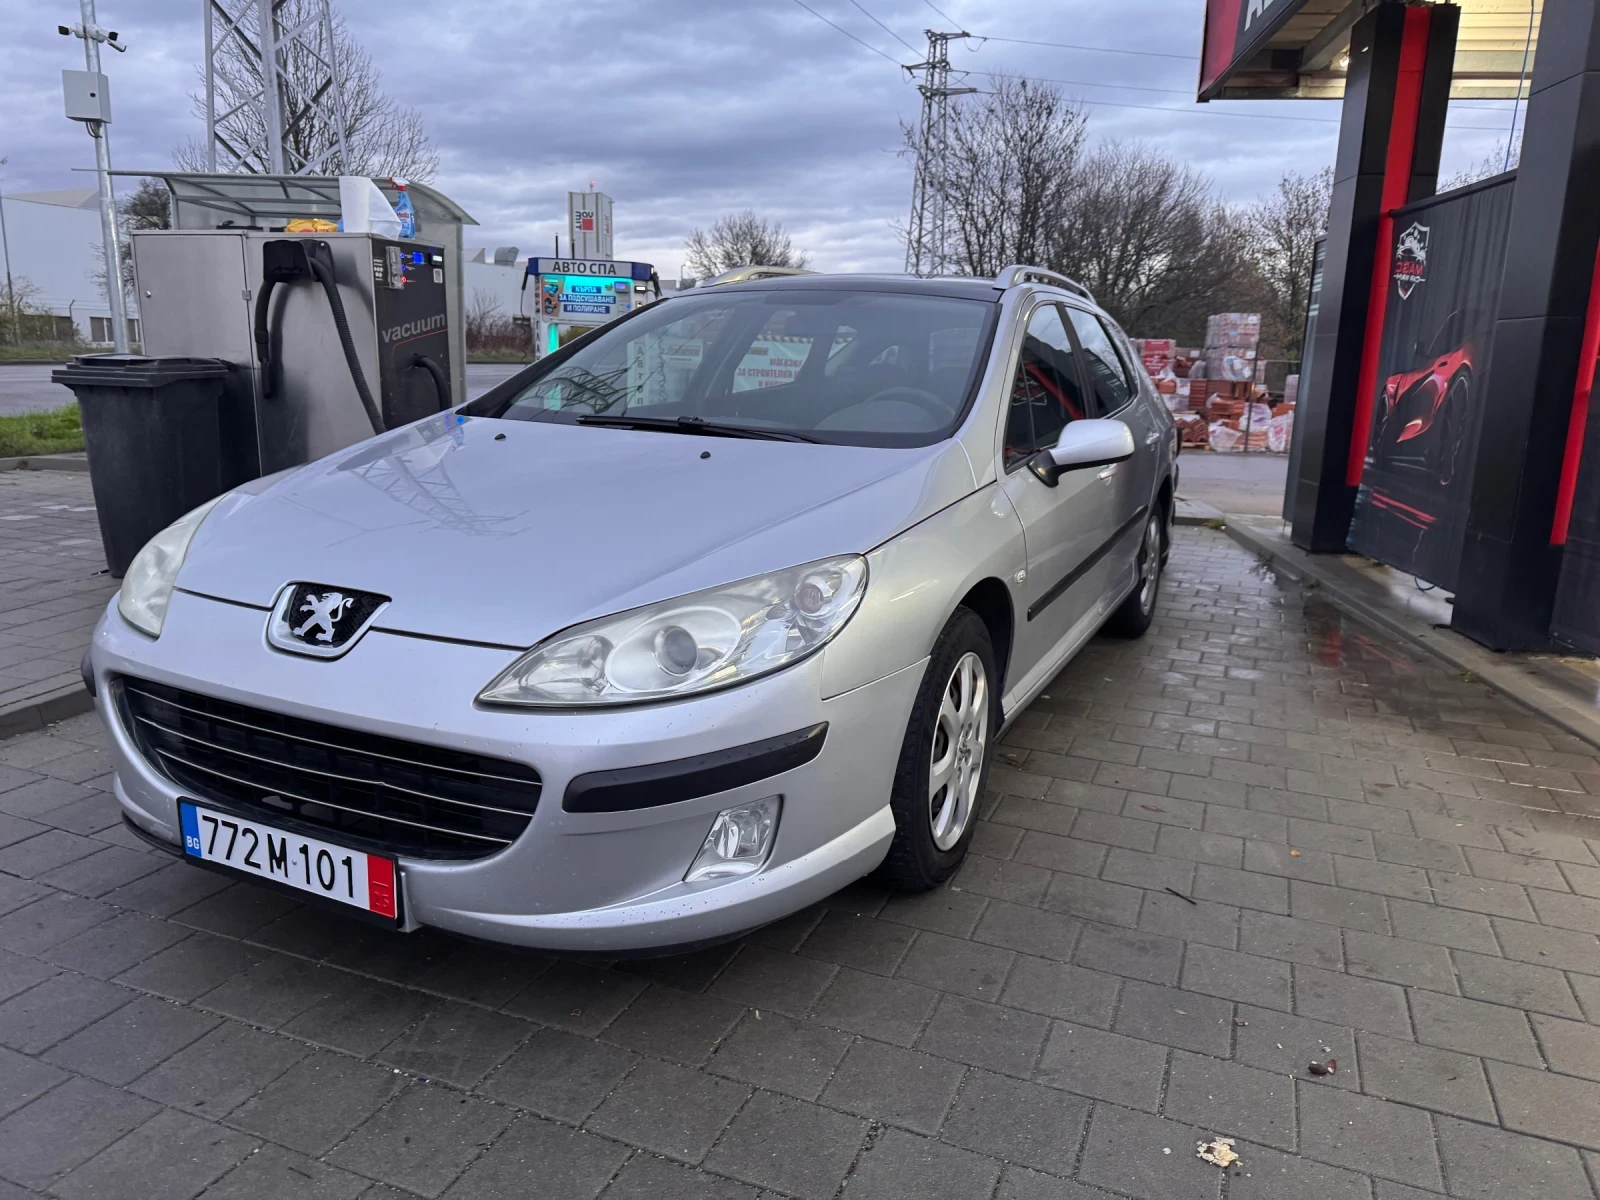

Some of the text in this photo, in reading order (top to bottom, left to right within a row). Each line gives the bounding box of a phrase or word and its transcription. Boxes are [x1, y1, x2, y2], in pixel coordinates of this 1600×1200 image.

[552, 261, 617, 275] АВТО СПА
[568, 295, 615, 303] ПОДСУШАВАНЕ
[572, 305, 607, 313] ПОЛИРАНЕ
[381, 313, 446, 343] vacuum
[186, 835, 200, 850] BG
